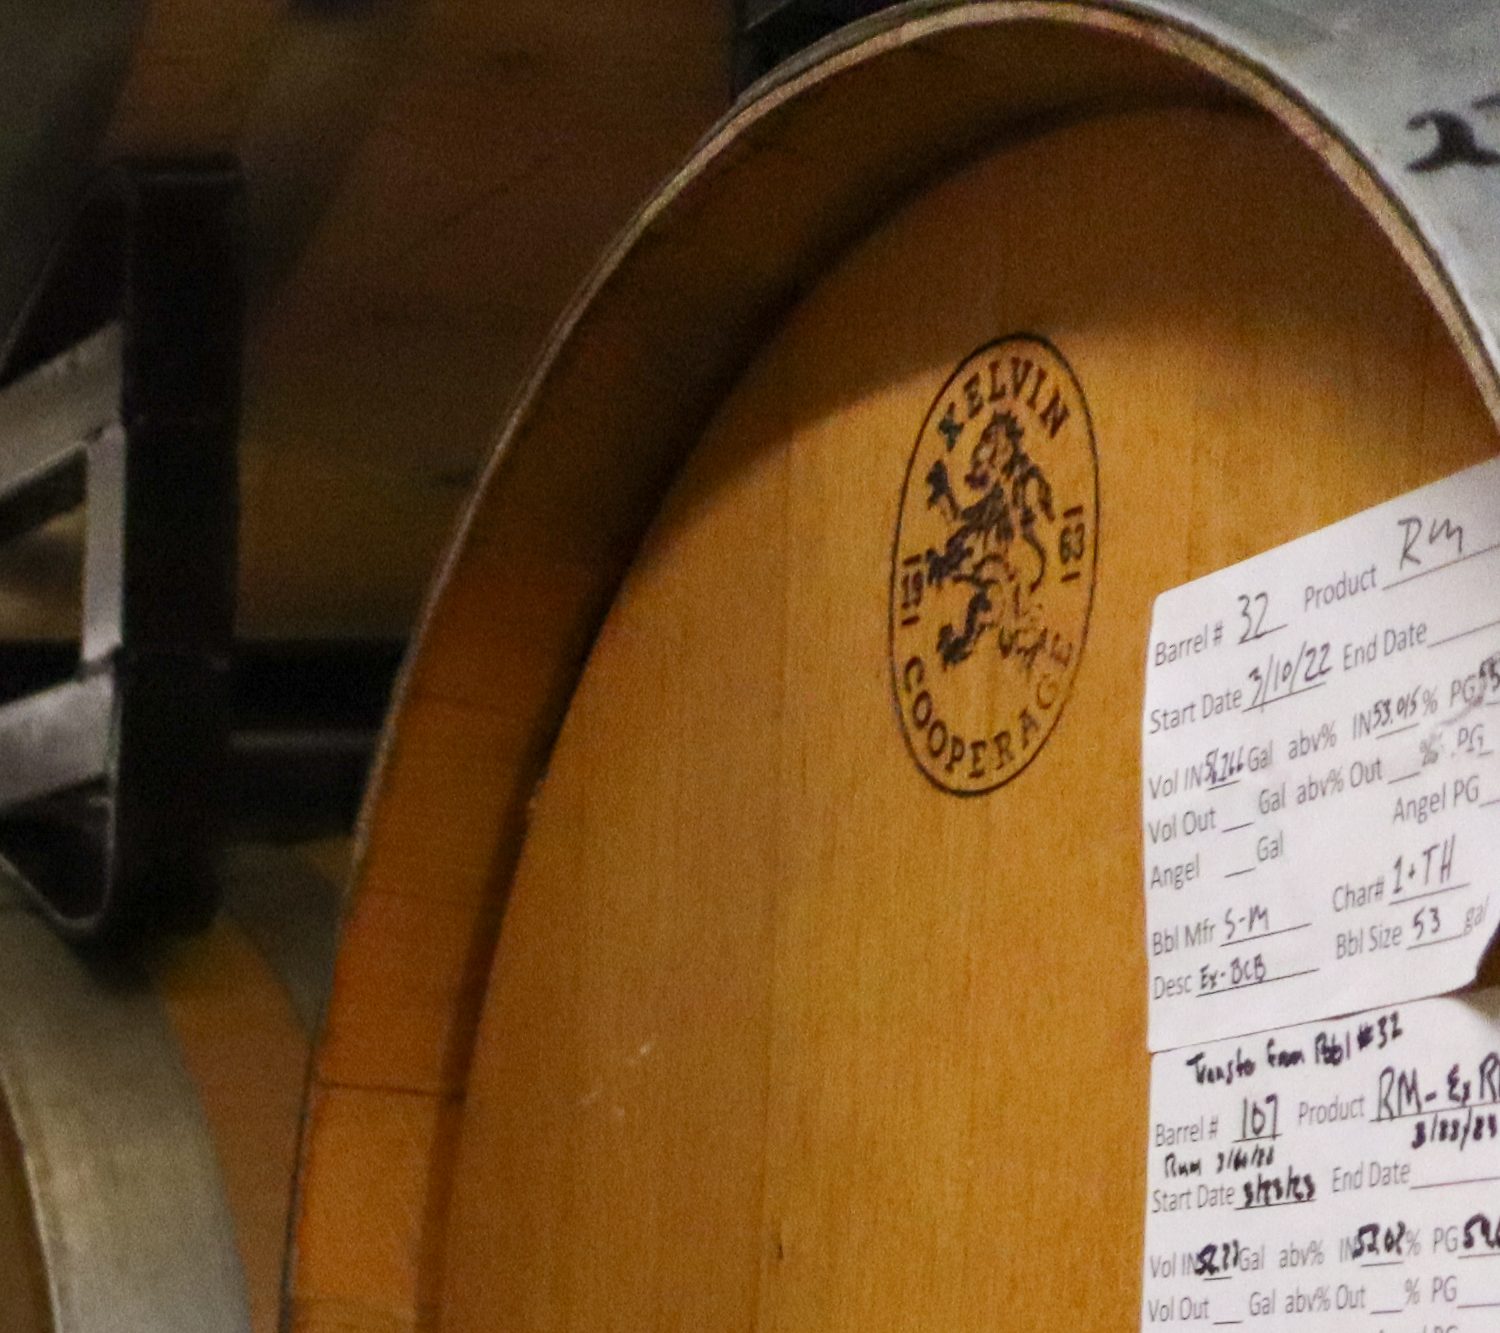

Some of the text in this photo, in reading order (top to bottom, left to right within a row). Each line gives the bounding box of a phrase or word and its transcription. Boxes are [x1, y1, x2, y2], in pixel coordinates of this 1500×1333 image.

[937, 355, 1070, 452] KELVIN
[1155, 624, 1208, 667] Barrel
[1238, 591, 1270, 644] 32
[1304, 564, 1377, 612] Product
[901, 629, 1076, 779] COOPERAGE
[1149, 701, 1195, 734] Start
[1202, 689, 1243, 719] Date
[1342, 640, 1377, 671] End
[1384, 619, 1427, 658] Date
[1149, 769, 1178, 800] Vol
[1184, 763, 1202, 791] IN
[1248, 740, 1273, 772] Gal
[1288, 722, 1337, 761] abv%
[1352, 711, 1372, 740] IN
[1148, 815, 1177, 844] Vol
[1183, 808, 1216, 835] Out
[1258, 782, 1285, 815] Gal
[1297, 768, 1344, 805] abv%
[1350, 757, 1382, 788] Out
[1151, 775, 1479, 890] Angel Gal Angel PG
[1152, 928, 1179, 956] Bbl
[1185, 918, 1216, 947] Mfr
[1333, 877, 1385, 912] Char#
[1153, 976, 1193, 1000] Desc
[1336, 929, 1363, 960] Bbl
[1368, 925, 1402, 952] Size
[1411, 906, 1442, 940] 53
[1463, 894, 1490, 935] gal
[1155, 1115, 1204, 1147] Barrel
[1242, 1094, 1278, 1140] 107
[1299, 1095, 1365, 1126] Product
[1152, 1187, 1192, 1214] Start
[1198, 1184, 1235, 1209] Date
[1332, 1161, 1363, 1193] End
[1369, 1161, 1410, 1188] Date
[1150, 1253, 1176, 1279] Vol
[1239, 1245, 1265, 1272] Gal
[1279, 1240, 1325, 1268] abv%
[1433, 1226, 1458, 1254] PG
[1148, 1297, 1173, 1323] Vol
[1180, 1297, 1210, 1321] Out
[1250, 1289, 1275, 1316] Gal
[1285, 1286, 1331, 1314] abv%
[1336, 1284, 1366, 1310] Out
[1432, 1275, 1457, 1303] PG
